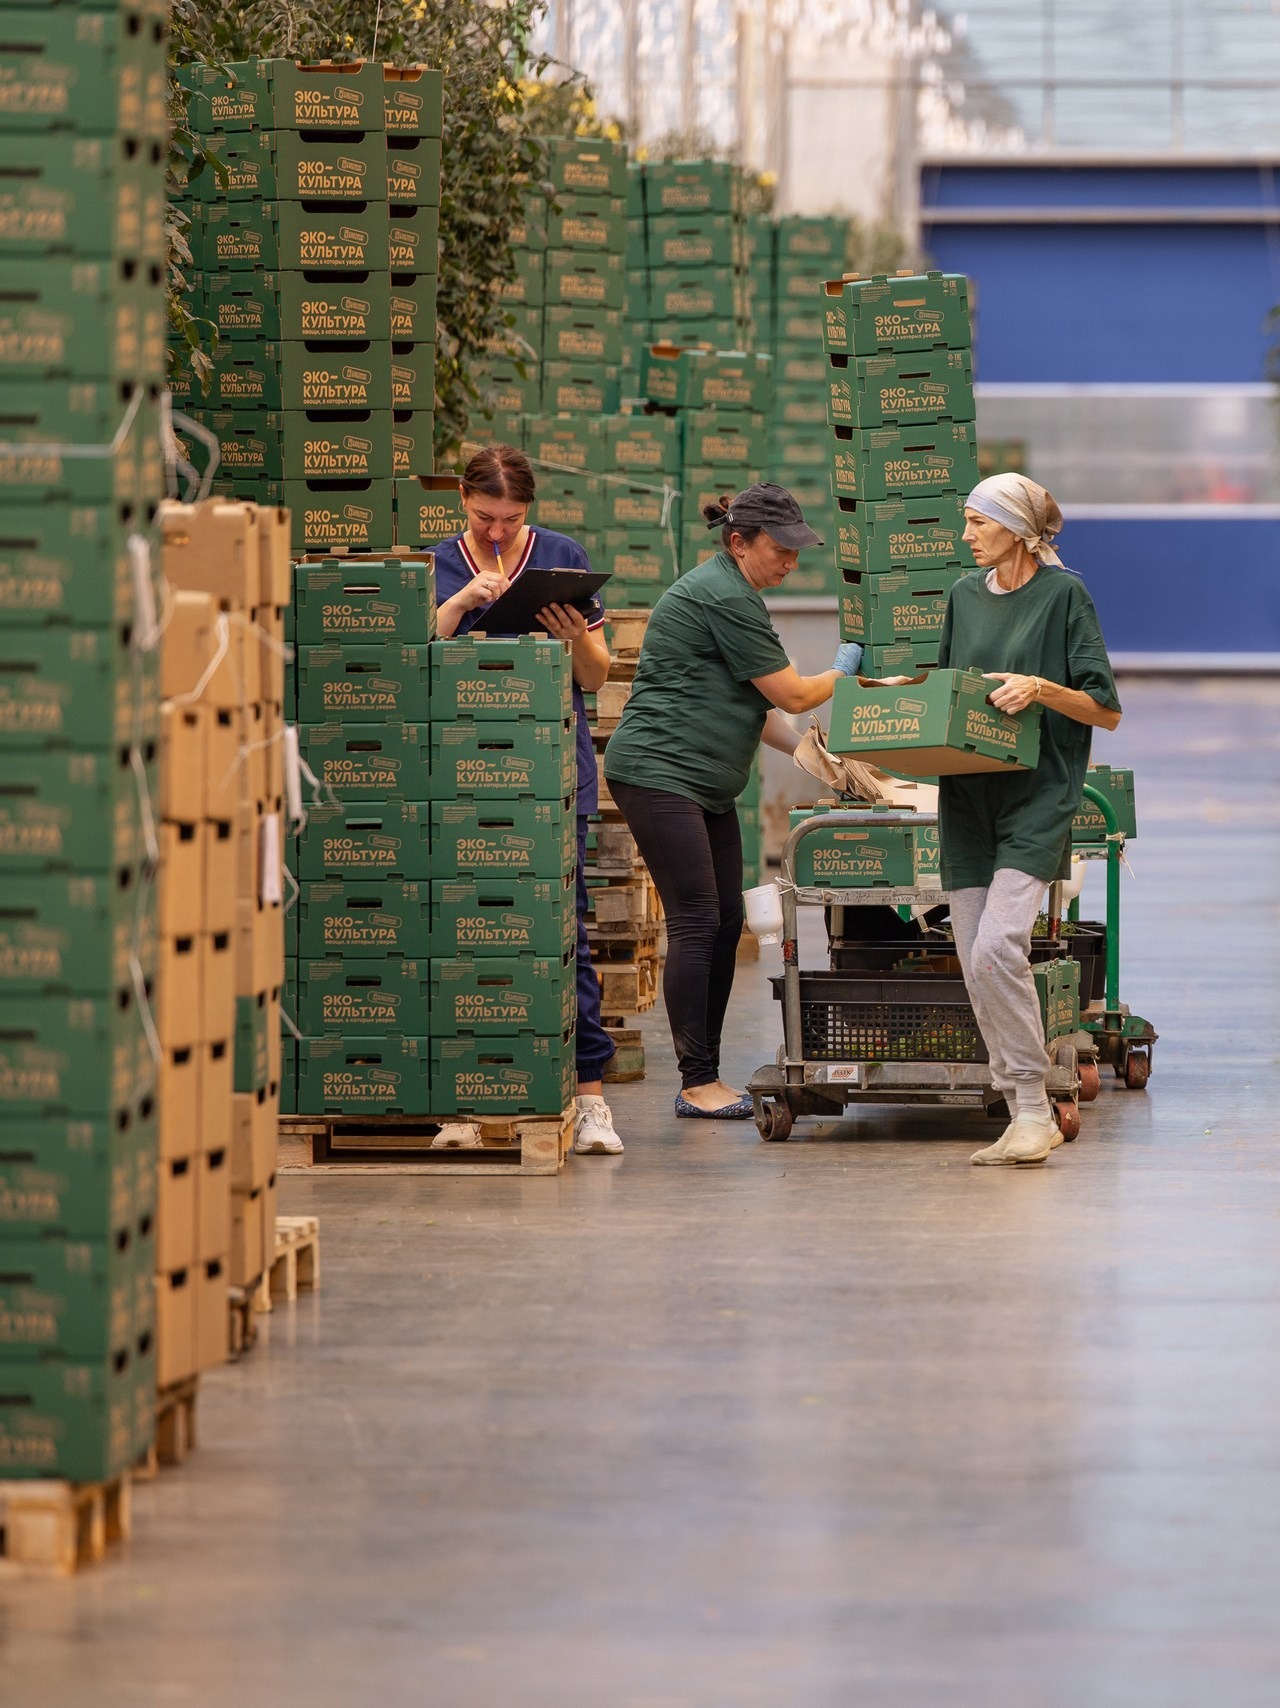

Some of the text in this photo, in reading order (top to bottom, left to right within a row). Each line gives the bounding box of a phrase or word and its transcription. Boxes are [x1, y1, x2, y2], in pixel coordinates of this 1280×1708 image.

[295, 90, 330, 104] ЭКО-
[212, 104, 255, 116] КУЛЬТУРА
[295, 104, 360, 119] КУЛЬТУРА
[386, 109, 419, 122] ТУРА
[298, 161, 333, 175] ЭКО-
[215, 174, 258, 186] КЛЬТУРА
[298, 175, 363, 189] КУЛЬТУРА
[300, 231, 336, 244] ЭКО-
[218, 244, 260, 254] КУЛЬТУРА
[301, 245, 365, 259] КУЛЬТУРА
[302, 302, 337, 314] ЭКО-
[220, 314, 261, 323] КУЛЬТУРА
[302, 315, 366, 328] КУЛЬТУРА
[874, 314, 910, 326] ЭКО-
[876, 322, 941, 336] КУЛЬТУРА
[303, 371, 338, 384] ЭКО-
[221, 383, 263, 393] КУЛЬТУРА
[303, 385, 367, 398] КУЛЬТУРА
[880, 387, 916, 399] ЭКО-
[881, 395, 945, 409] КУЛЬТУРА
[304, 441, 339, 454] ЭКО-
[222, 452, 264, 462] КУЛЬТУРА
[304, 454, 368, 467] КУЛЬТУРА
[884, 460, 920, 471] ЭКО-
[885, 468, 950, 482] КУЛЬТУРА
[304, 510, 339, 523] ЭКО-
[420, 505, 454, 518] ЭКО-
[305, 523, 368, 536] КУЛЬТУРА
[420, 519, 467, 532] КУЛЬТУ
[888, 532, 924, 544] ЭКО-
[890, 541, 954, 554] КУЛЬТУРА
[322, 605, 362, 615] ЭКО-
[892, 604, 928, 616] ЭКО-
[323, 616, 396, 627] КУЛЬТУРА
[323, 682, 363, 693] ЭКО-
[456, 680, 497, 691] ЭКО-
[324, 693, 396, 704] КУЛЬТУРА
[457, 692, 530, 703] КУЛЬТУРА
[852, 704, 891, 720] ЭКО-
[967, 709, 996, 727] ЭКО-
[851, 717, 921, 735] КУЛЬТУРА
[966, 720, 1018, 744] КУЛЬТУРА
[323, 760, 363, 771] ЭКО-
[456, 760, 496, 771] ЭКО-
[324, 771, 396, 782] КУЛЬТУРА
[457, 771, 529, 782] КУЛЬТУРА
[323, 839, 363, 849] ЭКО-
[456, 839, 497, 849] ЭКО-
[324, 850, 396, 861] КУЛЬТУРА
[457, 850, 530, 861] КУЛЬТУРА
[813, 849, 851, 859] ЭКО-
[814, 860, 883, 870] КУЛЬТУРА
[324, 917, 364, 927] ЭКО-
[456, 917, 496, 928] ЭКО-
[324, 928, 397, 939] КУЛЬТУРА
[457, 929, 529, 939] КУЛЬТУРА
[323, 995, 363, 1006] ЭКО-
[455, 995, 495, 1005] ЭКО-
[323, 1006, 396, 1017] КУЛЬТУРА
[455, 1006, 528, 1017] КУЛЬТУРА
[323, 1073, 363, 1083] ЭКО-
[455, 1073, 495, 1083] ЭКО-
[323, 1084, 396, 1095] КУЛЬТУРА
[456, 1084, 528, 1095] КУЛЬТУРА
